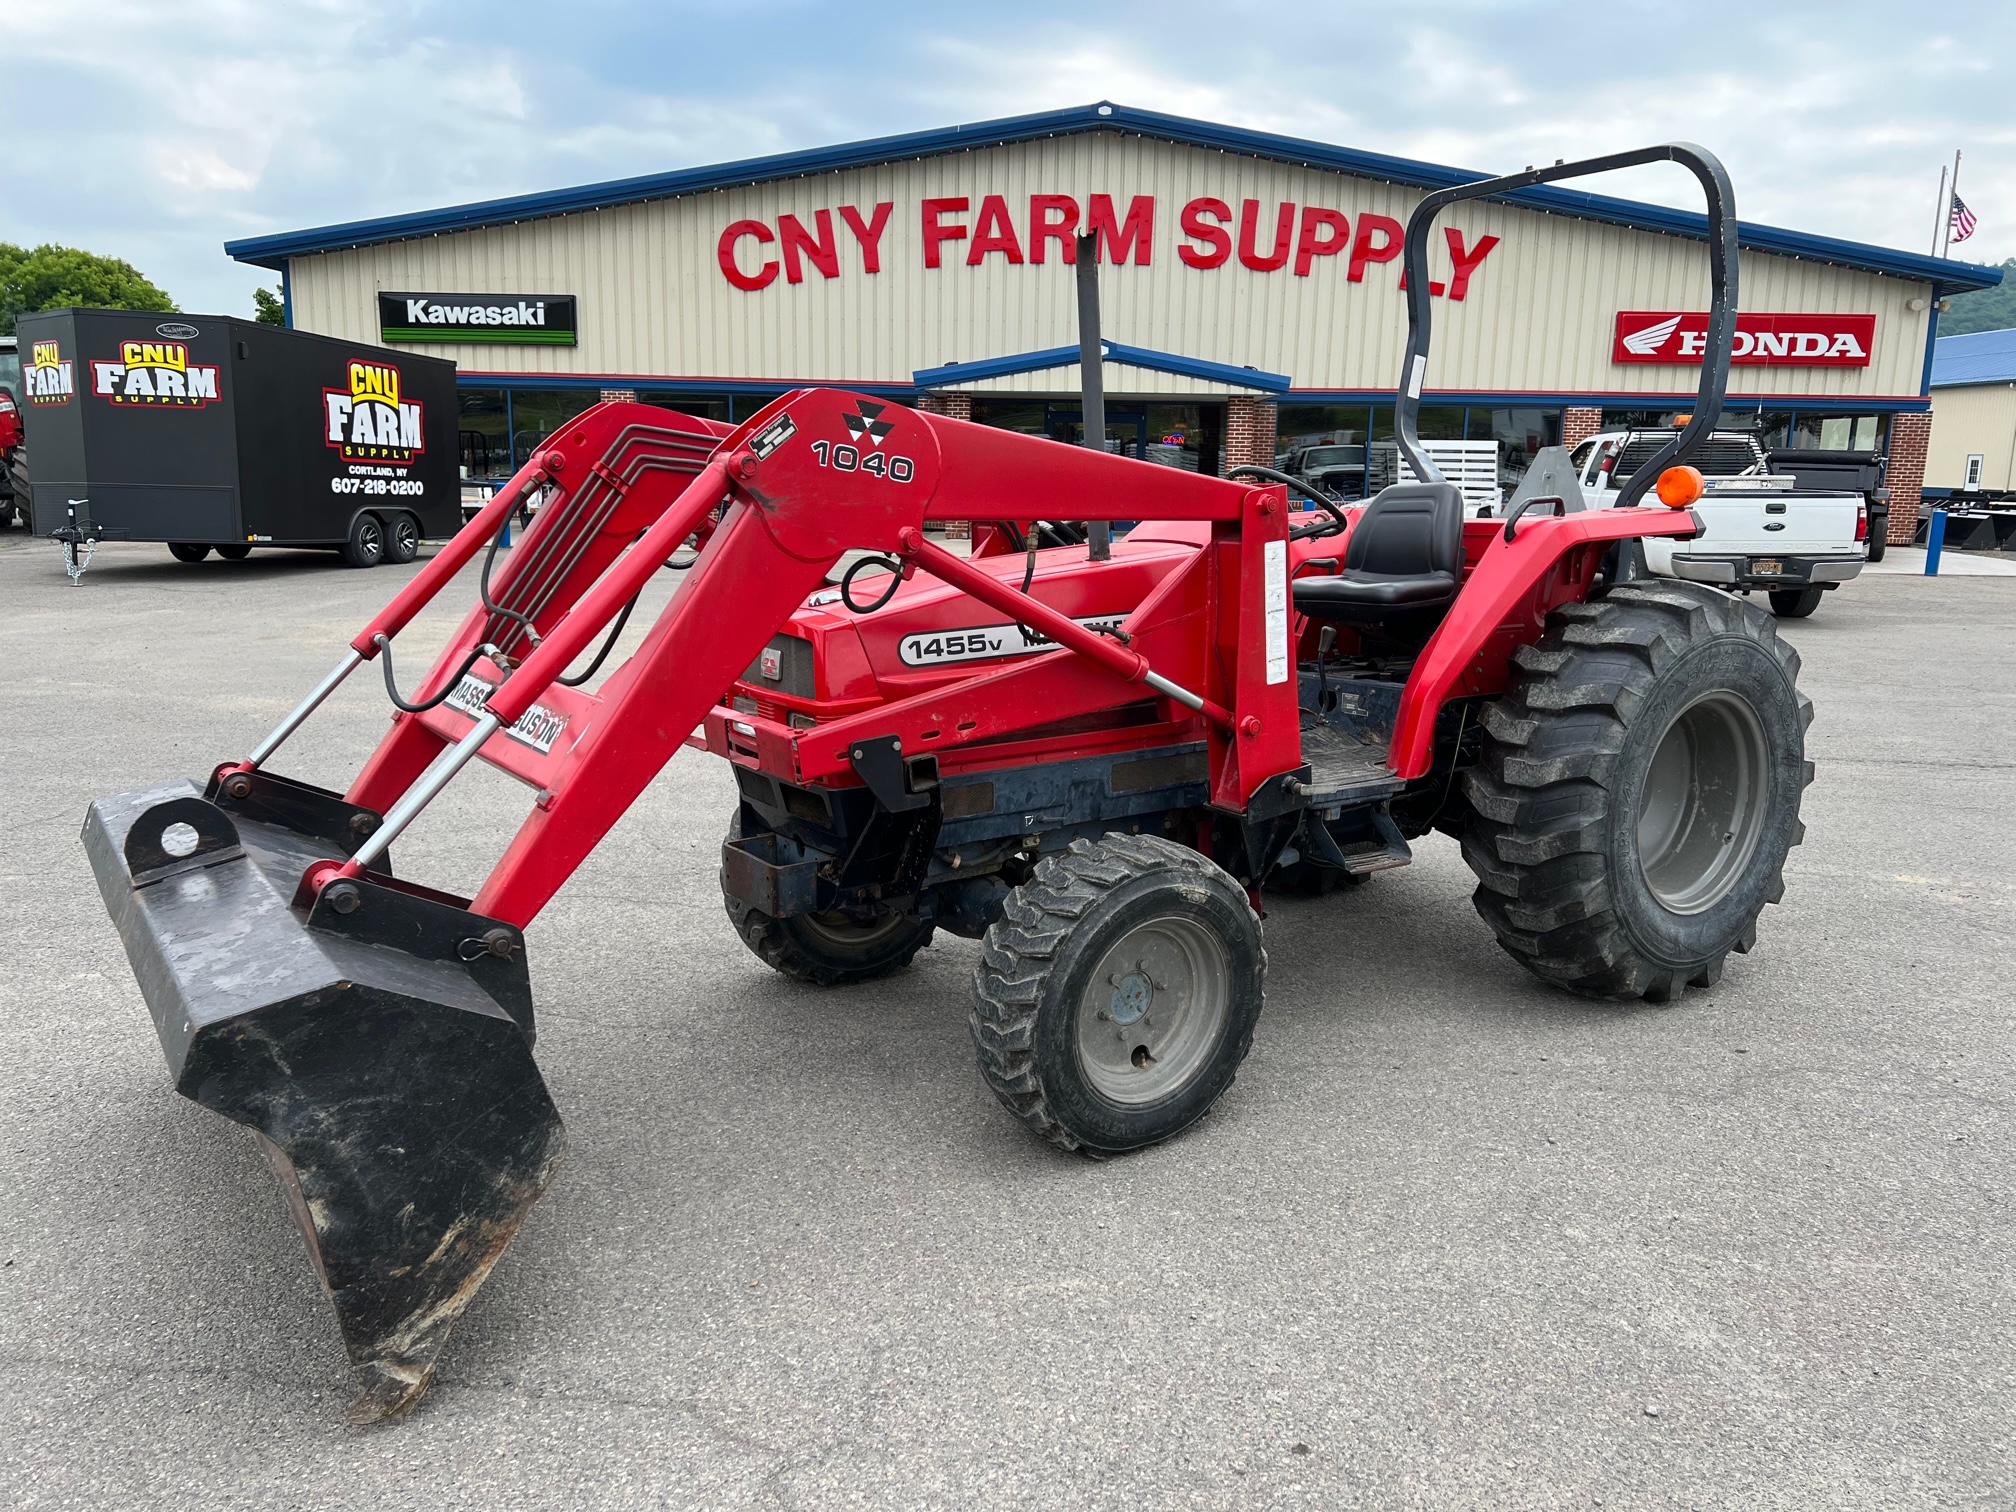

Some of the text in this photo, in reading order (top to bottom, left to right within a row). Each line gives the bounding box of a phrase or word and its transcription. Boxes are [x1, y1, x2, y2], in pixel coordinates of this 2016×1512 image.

[717, 202, 894, 291] CNY
[922, 194, 1155, 268] FARM
[407, 299, 546, 326] Kawasaki
[24, 364, 73, 396] FARM
[94, 363, 218, 399] FARM
[34, 395, 67, 404] SUPPLY
[115, 395, 199, 405] SUPPLY
[326, 393, 422, 449] FARM
[345, 446, 410, 459] SUPPLY
[811, 439, 914, 483] 1040
[348, 465, 408, 477] CORTLAND, NY
[331, 478, 424, 495] 607-218-0200
[1718, 542, 1772, 550] SUPER
[451, 679, 488, 712] MASSE
